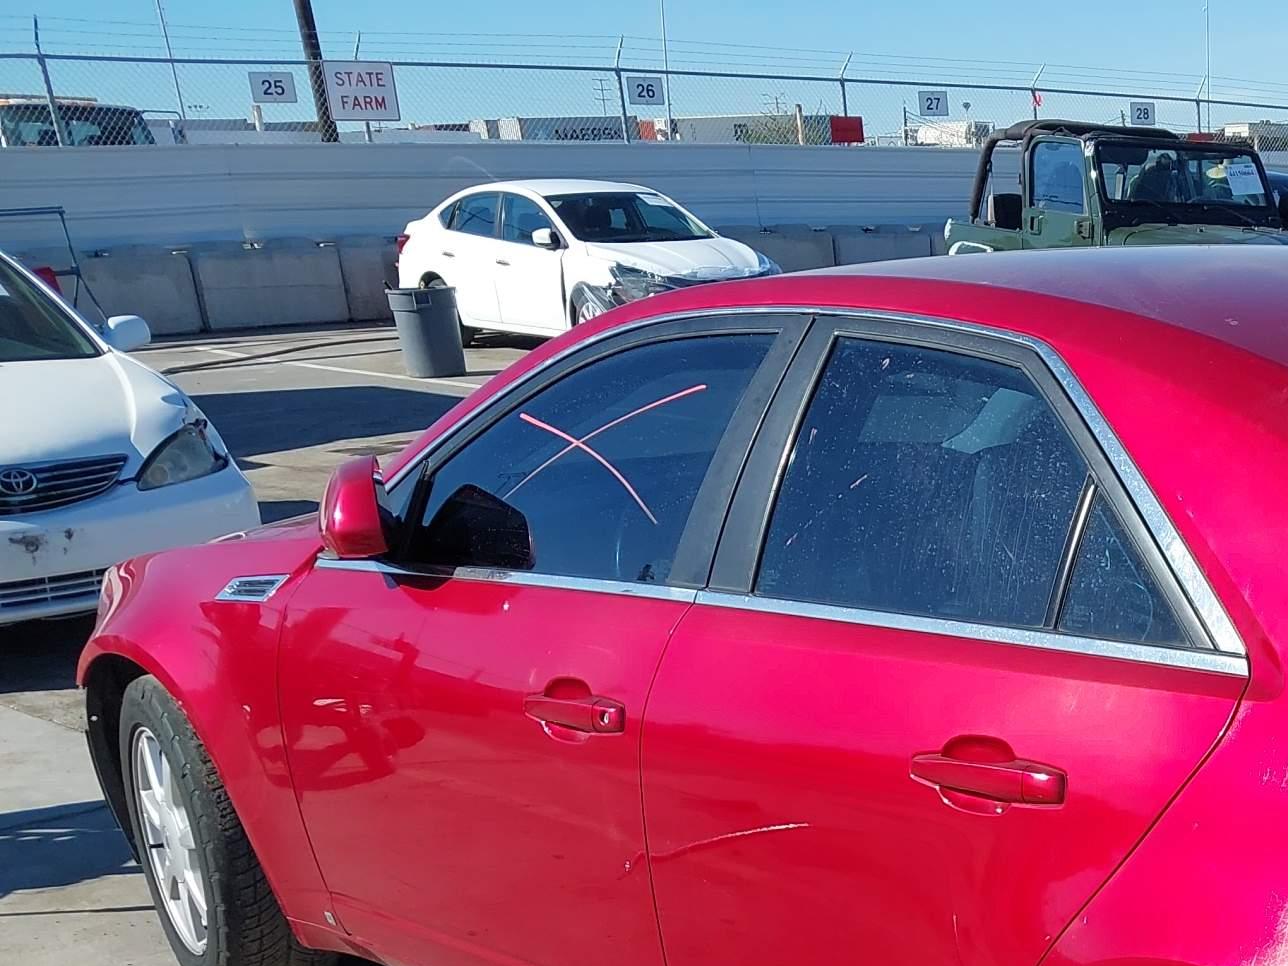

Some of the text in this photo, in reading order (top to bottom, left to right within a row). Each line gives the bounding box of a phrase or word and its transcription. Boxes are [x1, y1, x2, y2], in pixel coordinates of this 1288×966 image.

[261, 79, 286, 96] 25
[334, 71, 387, 88] STATE
[635, 83, 656, 99] 26
[340, 95, 388, 111] FARM
[926, 97, 941, 111] 27
[1136, 107, 1150, 120] 28
